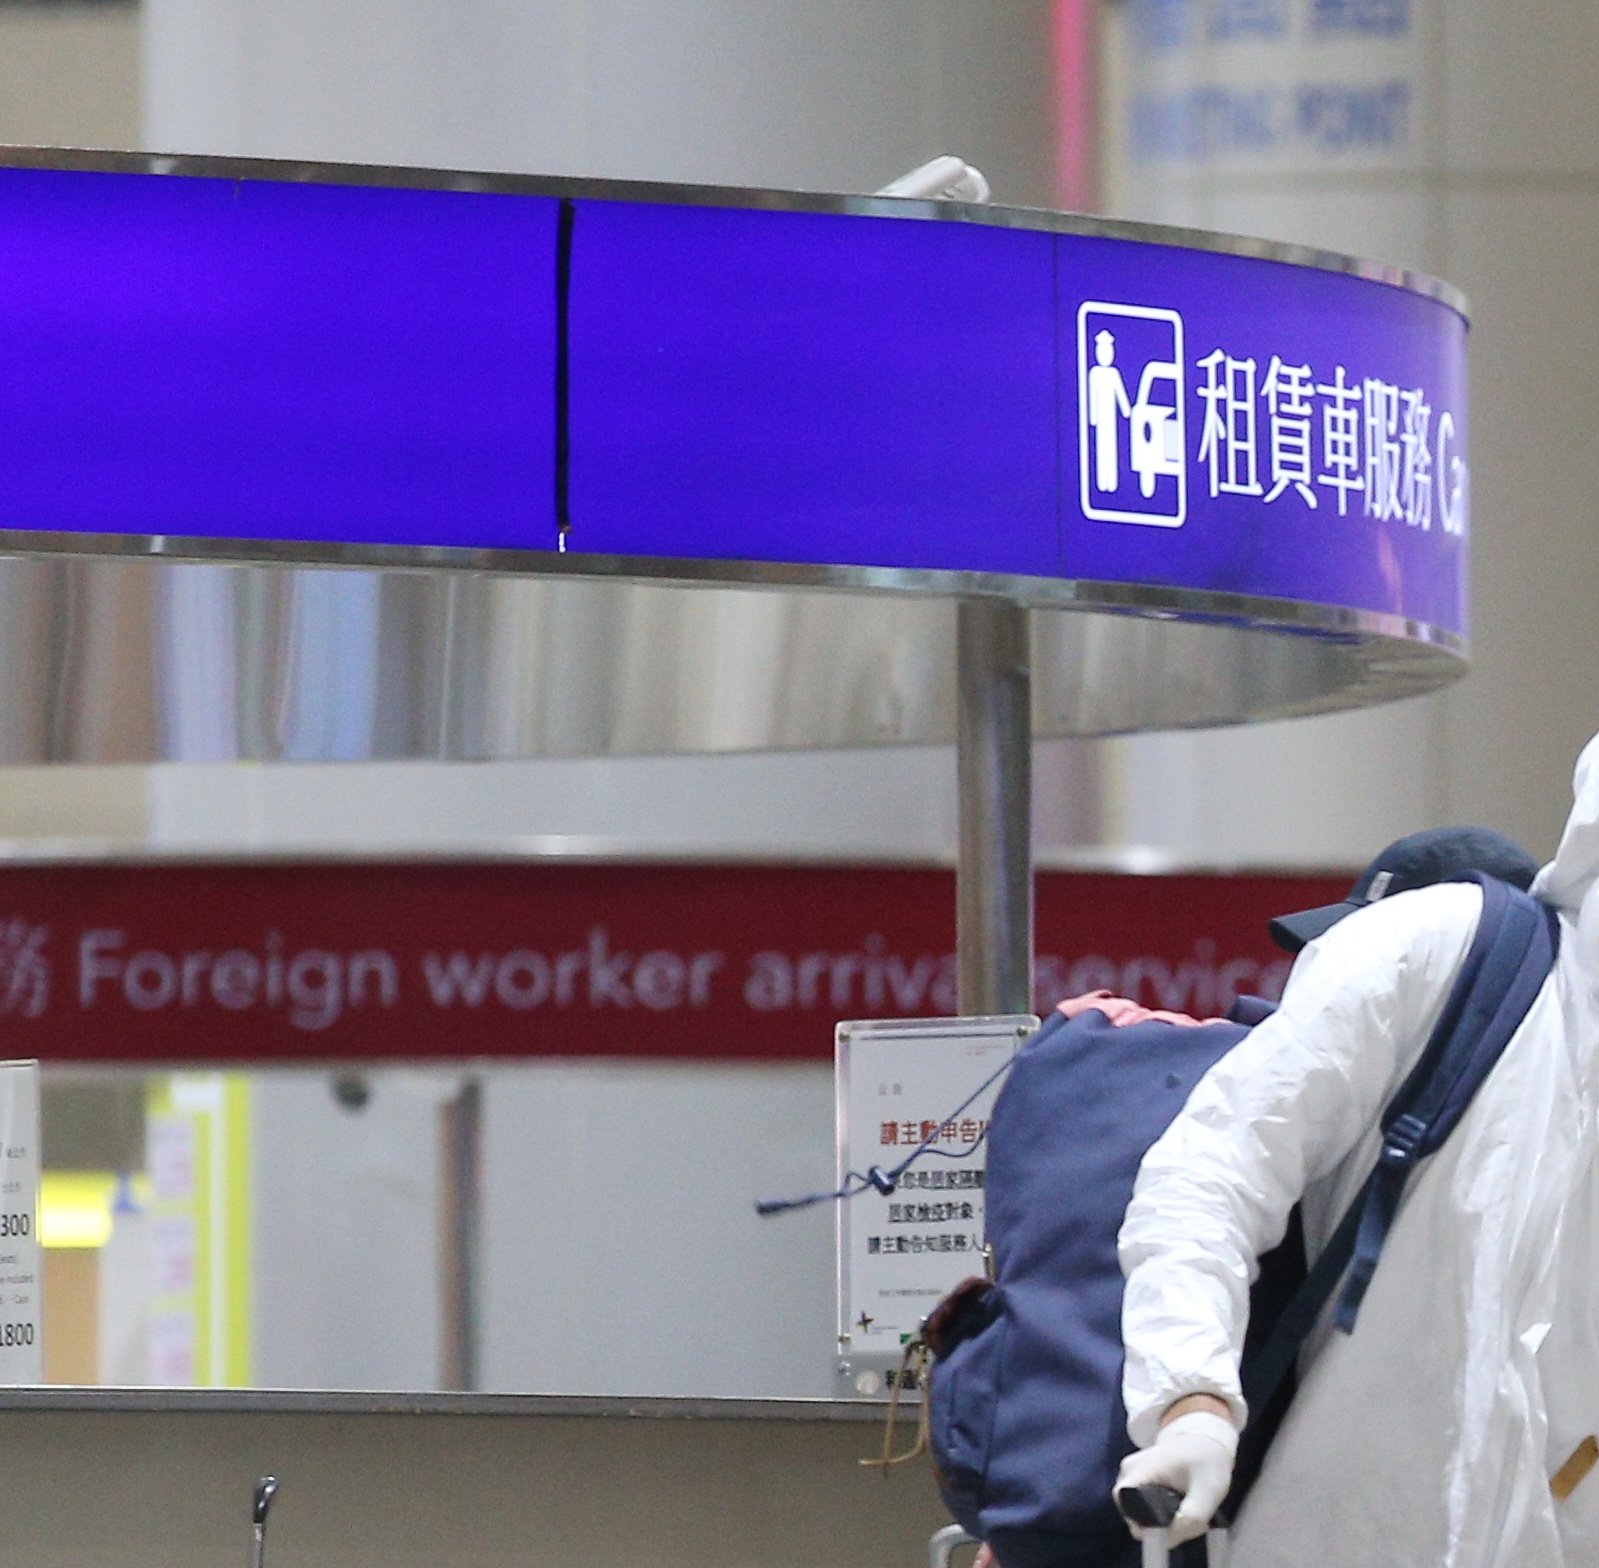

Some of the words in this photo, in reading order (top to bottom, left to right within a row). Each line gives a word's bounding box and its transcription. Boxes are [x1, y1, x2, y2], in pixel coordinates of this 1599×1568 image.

[1196, 348, 1432, 531] 租賃車服務
[78, 927, 401, 1032] Foreign
[420, 924, 726, 1010] worker
[742, 932, 958, 1011] arriva
